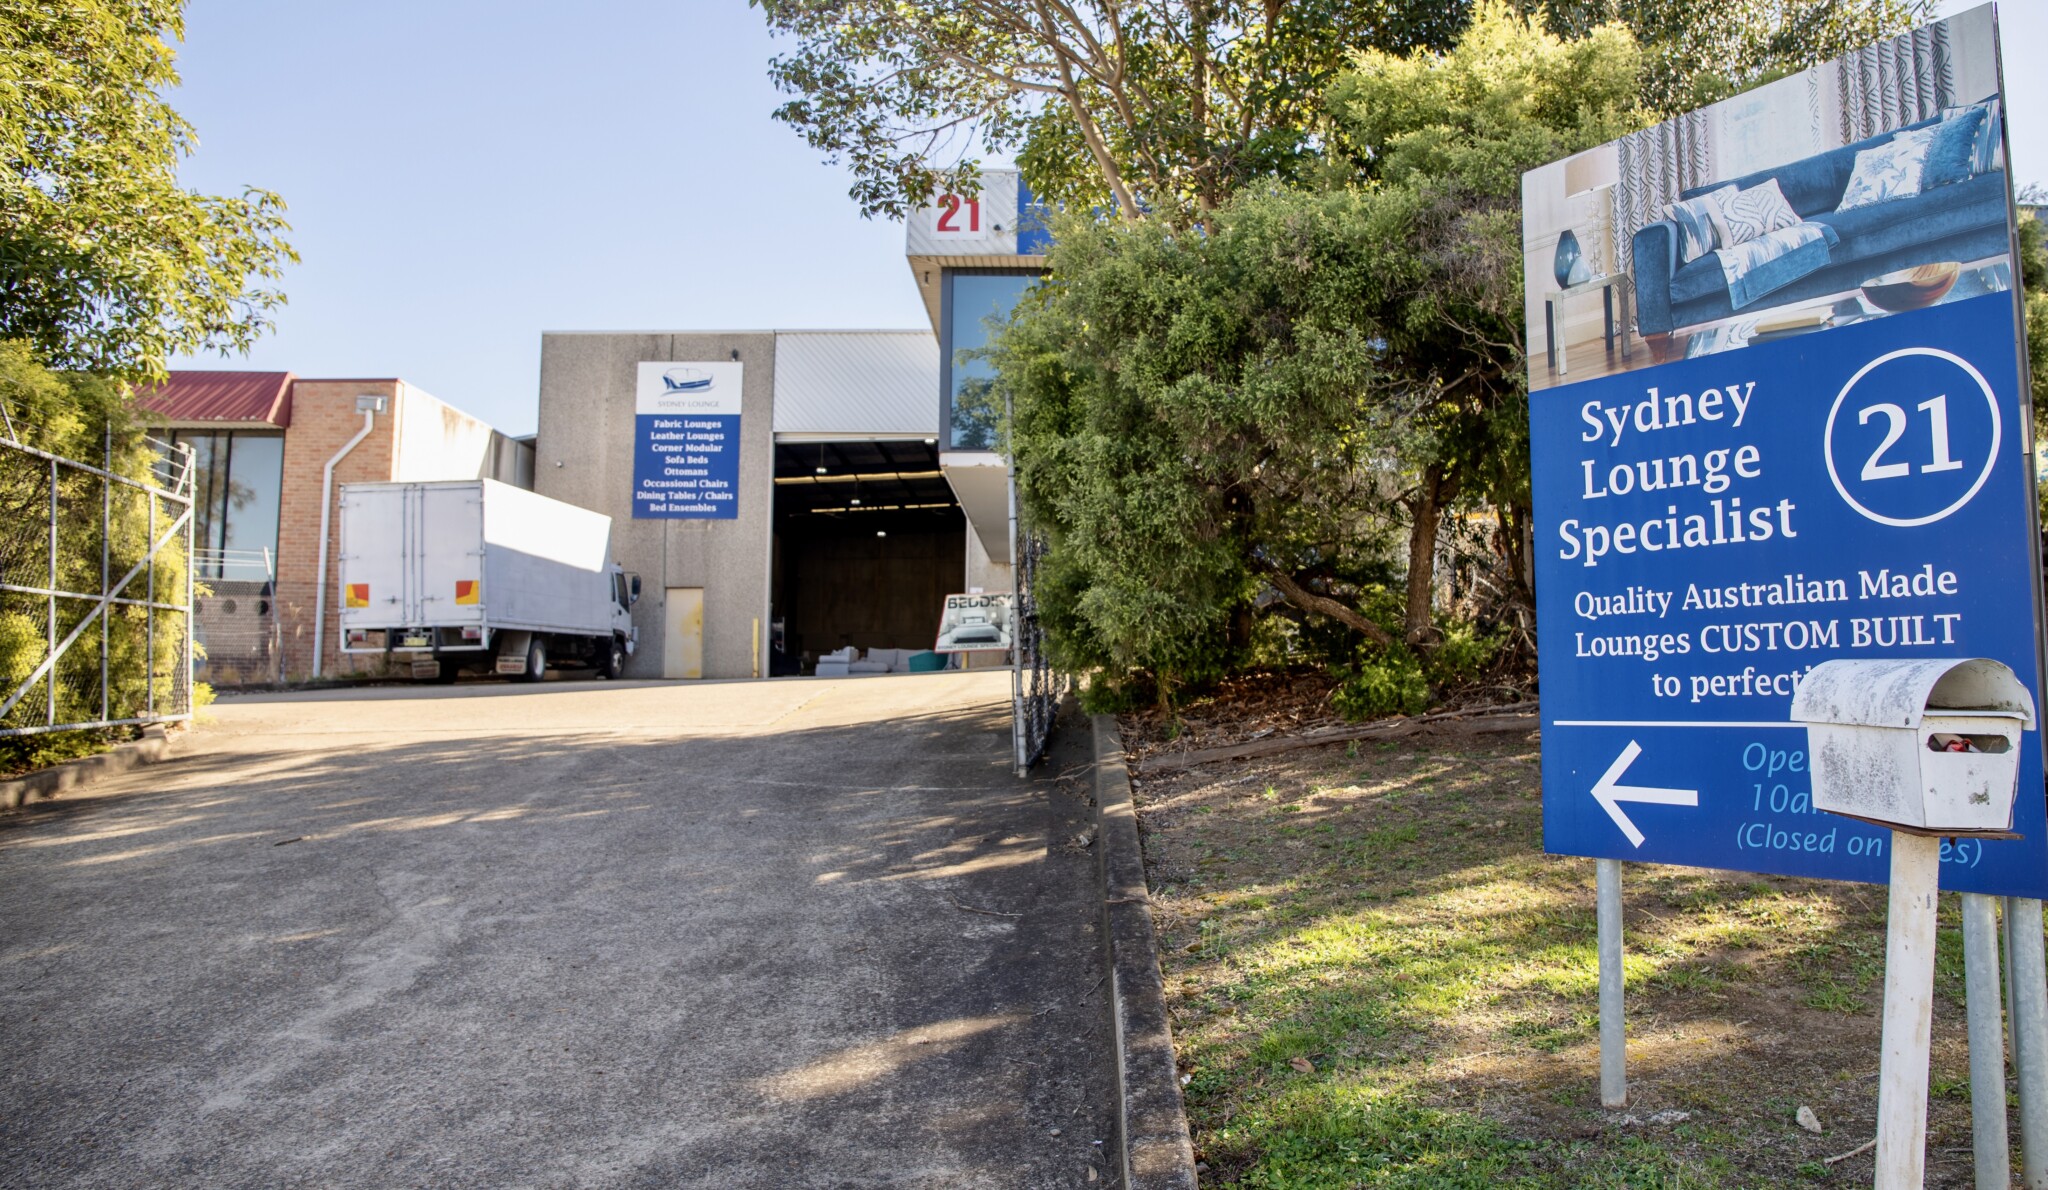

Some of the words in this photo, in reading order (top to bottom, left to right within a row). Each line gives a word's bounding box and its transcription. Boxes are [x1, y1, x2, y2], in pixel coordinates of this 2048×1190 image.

[937, 194, 979, 231] 21
[654, 420, 682, 428] Fabric
[684, 420, 722, 429] Lounges
[1582, 382, 1755, 447] Sydney
[651, 432, 684, 440] Leather
[687, 432, 724, 441] Lounges
[652, 444, 683, 452] Corner
[686, 444, 722, 452] Modular
[1859, 395, 1962, 481] 21
[664, 467, 708, 476] Ottomans
[665, 456, 684, 464] Sofa
[687, 456, 708, 464] Beds
[1582, 446, 1760, 499] Lounge
[637, 491, 666, 501] Dining
[668, 491, 696, 500] Tables
[705, 492, 733, 500] Chairs
[643, 479, 696, 488] Occassional
[699, 479, 728, 488] Chairs
[650, 503, 666, 512] Bed
[669, 503, 716, 512] Ensembles
[1560, 498, 1797, 567] Specialist
[1575, 587, 1672, 620] Quality
[1682, 574, 1848, 610] Australian
[1859, 564, 1957, 599] Made
[1576, 633, 1691, 661] Lounges
[1701, 620, 1839, 652] CUSTOM
[1851, 614, 1960, 647] BUILT
[1653, 673, 1681, 697] to
[1690, 665, 1811, 703] perfect
[1742, 742, 1811, 777] Ope
[1753, 784, 1828, 814] 10a
[1737, 821, 1836, 853] (Closed
[1847, 836, 1882, 856] on
